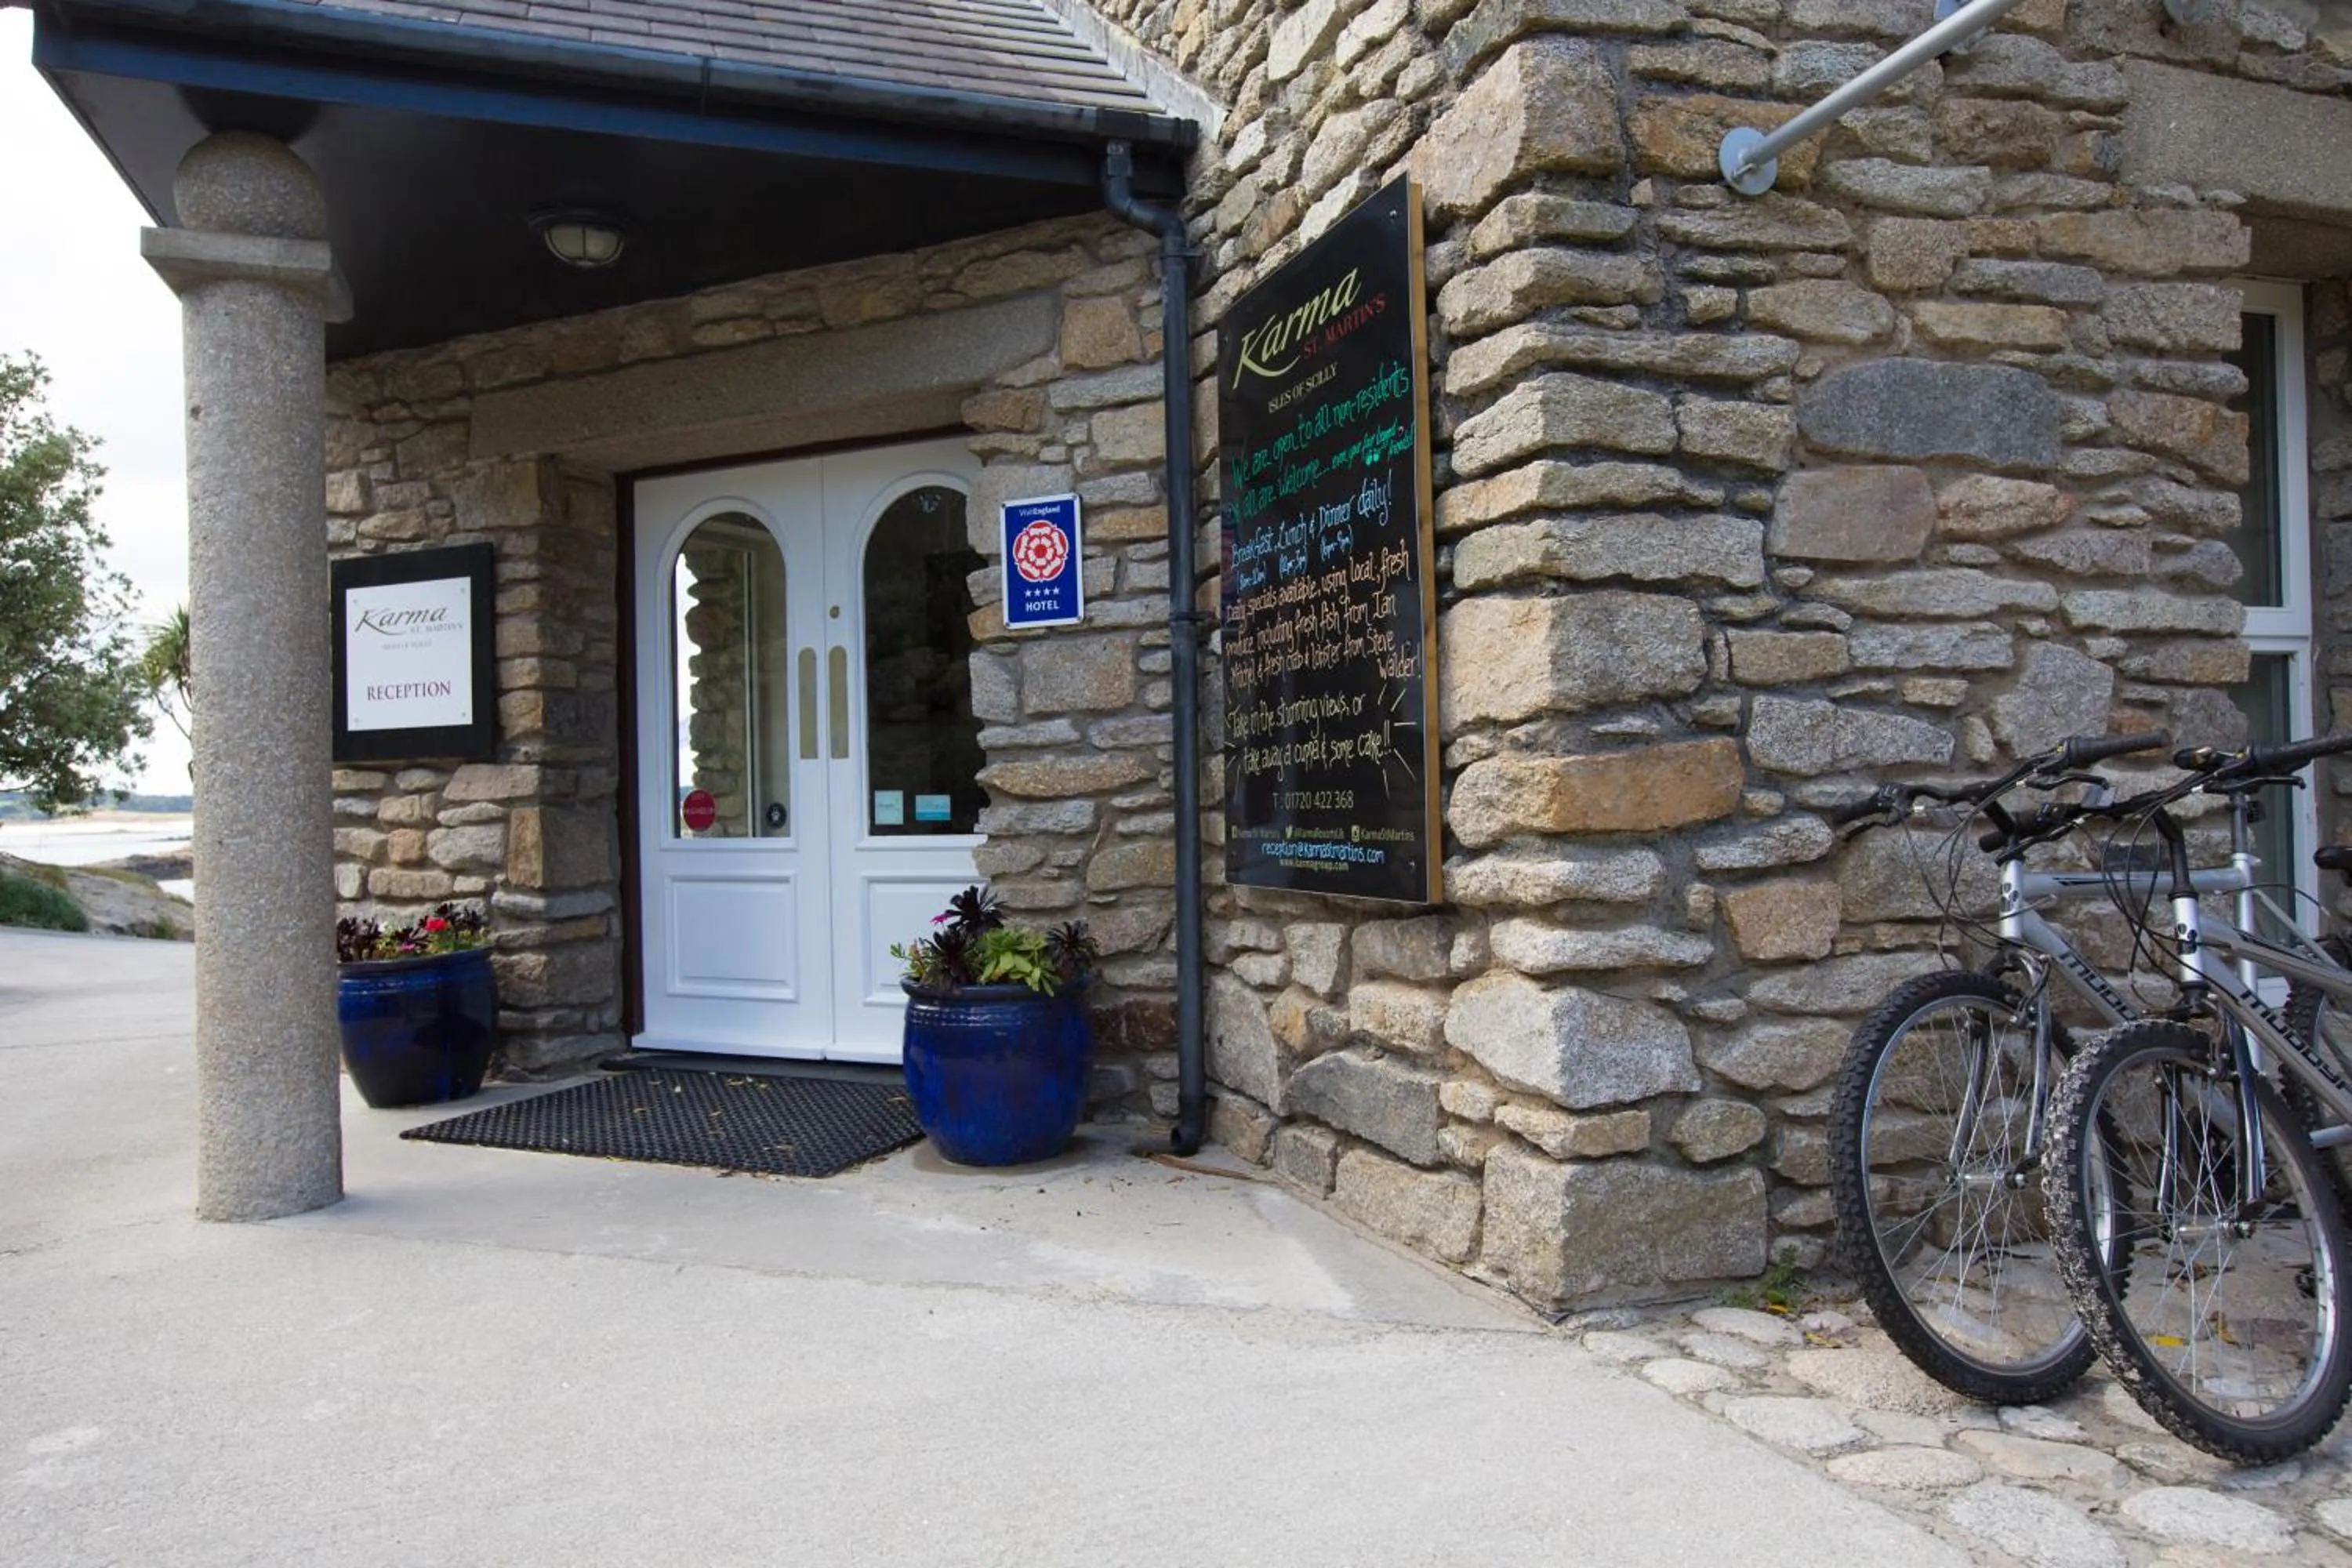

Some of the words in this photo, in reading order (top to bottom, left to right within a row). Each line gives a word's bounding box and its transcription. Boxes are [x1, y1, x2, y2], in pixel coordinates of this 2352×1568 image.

[1232, 267, 1362, 390] Karma
[1325, 292, 1388, 346] MARTIN'S
[1268, 391, 1292, 414] ISLES
[1293, 383, 1306, 401] OF
[1305, 361, 1339, 392] SCILLY
[1272, 432, 1299, 472] open
[1298, 413, 1313, 448] to
[1314, 403, 1332, 437] all
[1333, 361, 1410, 426] non-residents
[1321, 565, 1352, 605] using
[1381, 538, 1411, 593] fresh
[354, 607, 447, 636] Karma
[1025, 600, 1060, 612] HOTEL
[1319, 601, 1341, 641] fish
[1343, 597, 1373, 631] from
[1373, 590, 1397, 619] Ian
[1367, 627, 1397, 655] Steve
[366, 680, 452, 701] RECEPTION
[1228, 705, 1250, 740] Take
[1276, 695, 1320, 739] stunning
[1352, 693, 1367, 717] or
[1285, 791, 1312, 810] 01720
[1314, 790, 1333, 809] 422
[1334, 789, 1355, 809] 368
